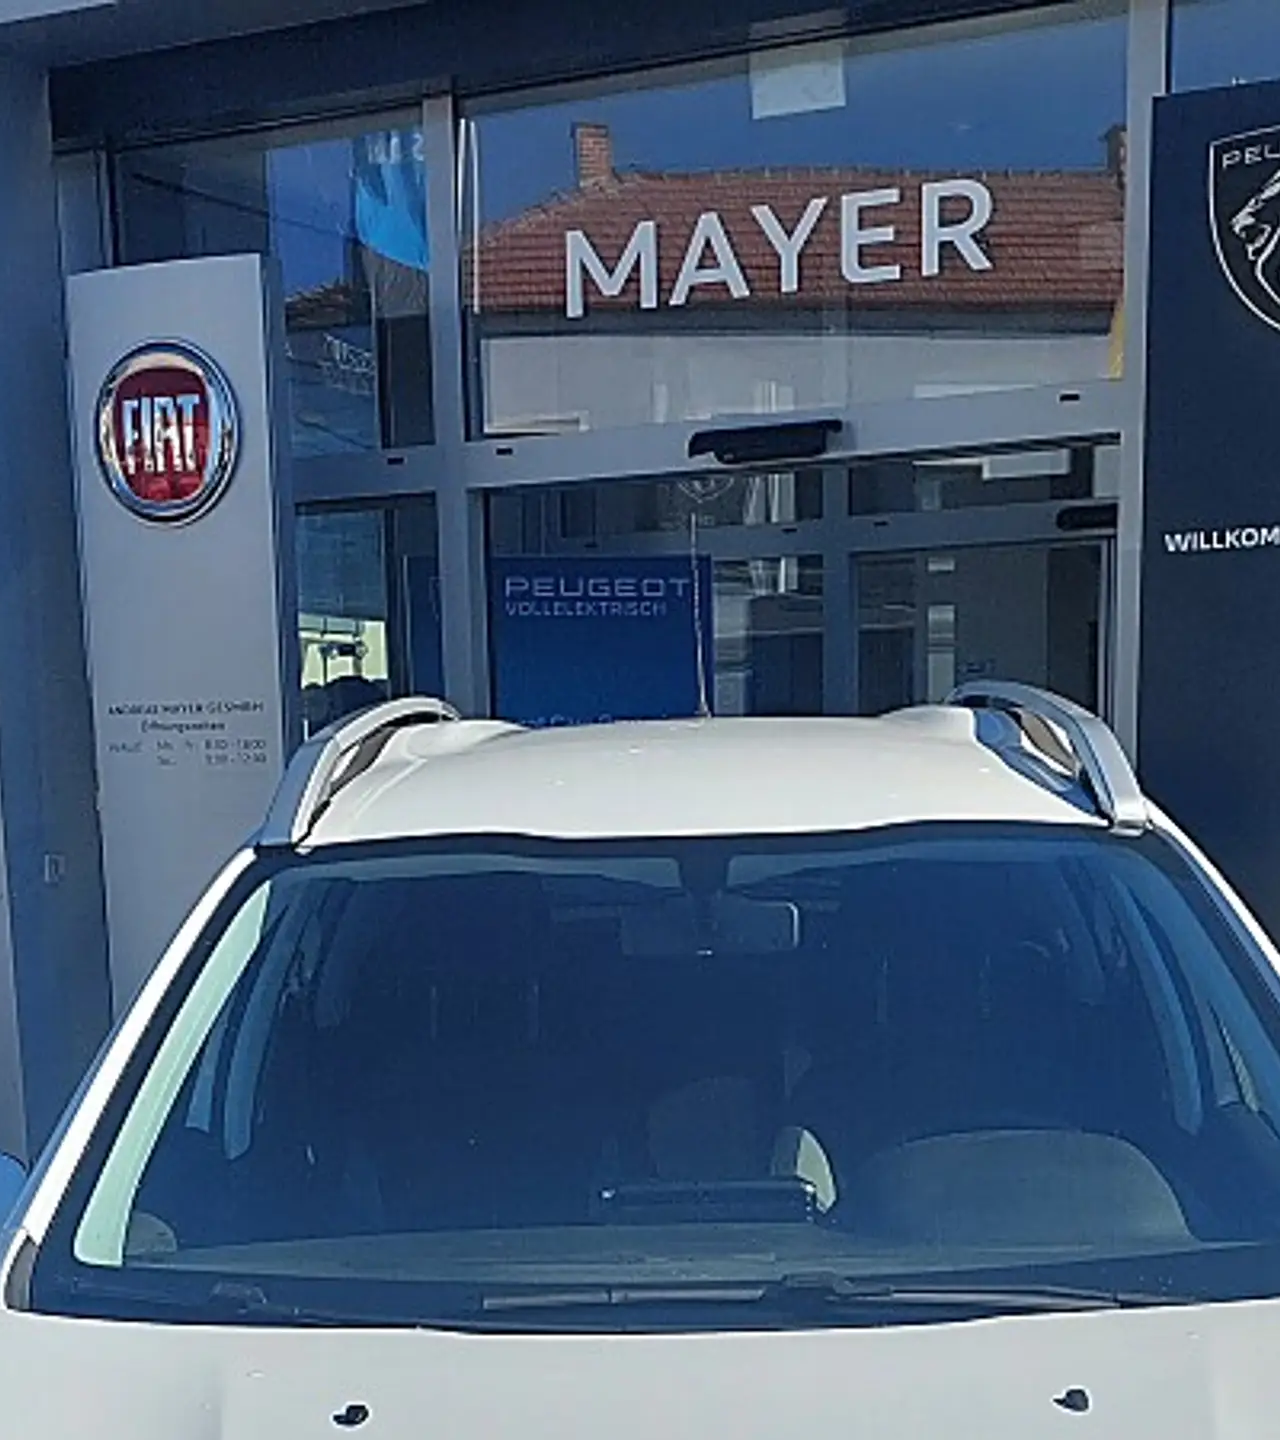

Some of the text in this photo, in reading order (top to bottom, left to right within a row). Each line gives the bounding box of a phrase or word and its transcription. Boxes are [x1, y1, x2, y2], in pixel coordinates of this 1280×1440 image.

[564, 177, 994, 319] MAYER
[122, 393, 200, 475] FIAT
[505, 576, 690, 598] PEUGEOT
[505, 601, 668, 617] VOLLELEKTRISCH
